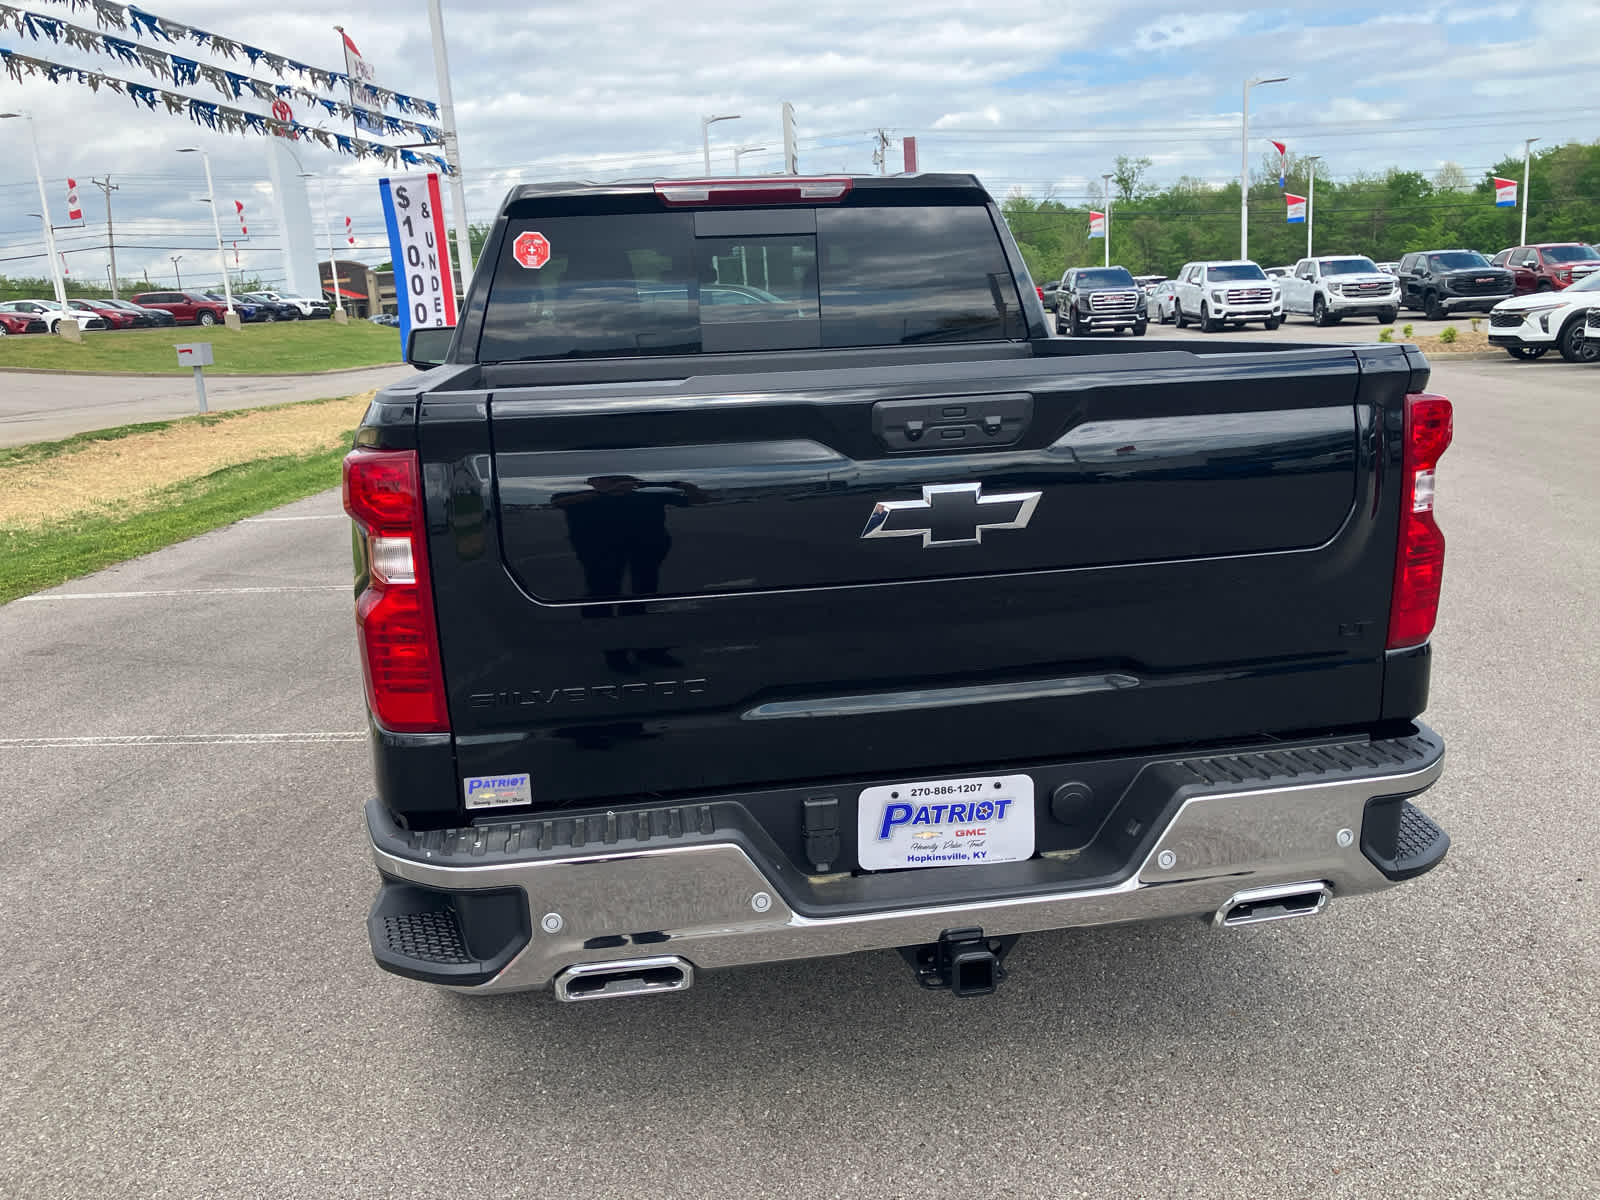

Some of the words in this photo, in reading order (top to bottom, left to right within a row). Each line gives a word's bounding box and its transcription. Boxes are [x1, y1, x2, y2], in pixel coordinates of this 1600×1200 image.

[421, 202, 431, 219] &
[469, 678, 707, 708] SILVERADO
[468, 776, 527, 795] PATRIOT
[911, 784, 983, 797] 270-886-1207
[878, 799, 1012, 841] PATRIOT
[955, 828, 987, 837] GMC
[907, 852, 970, 863] Hopkinsville,
[973, 851, 987, 859] KY
